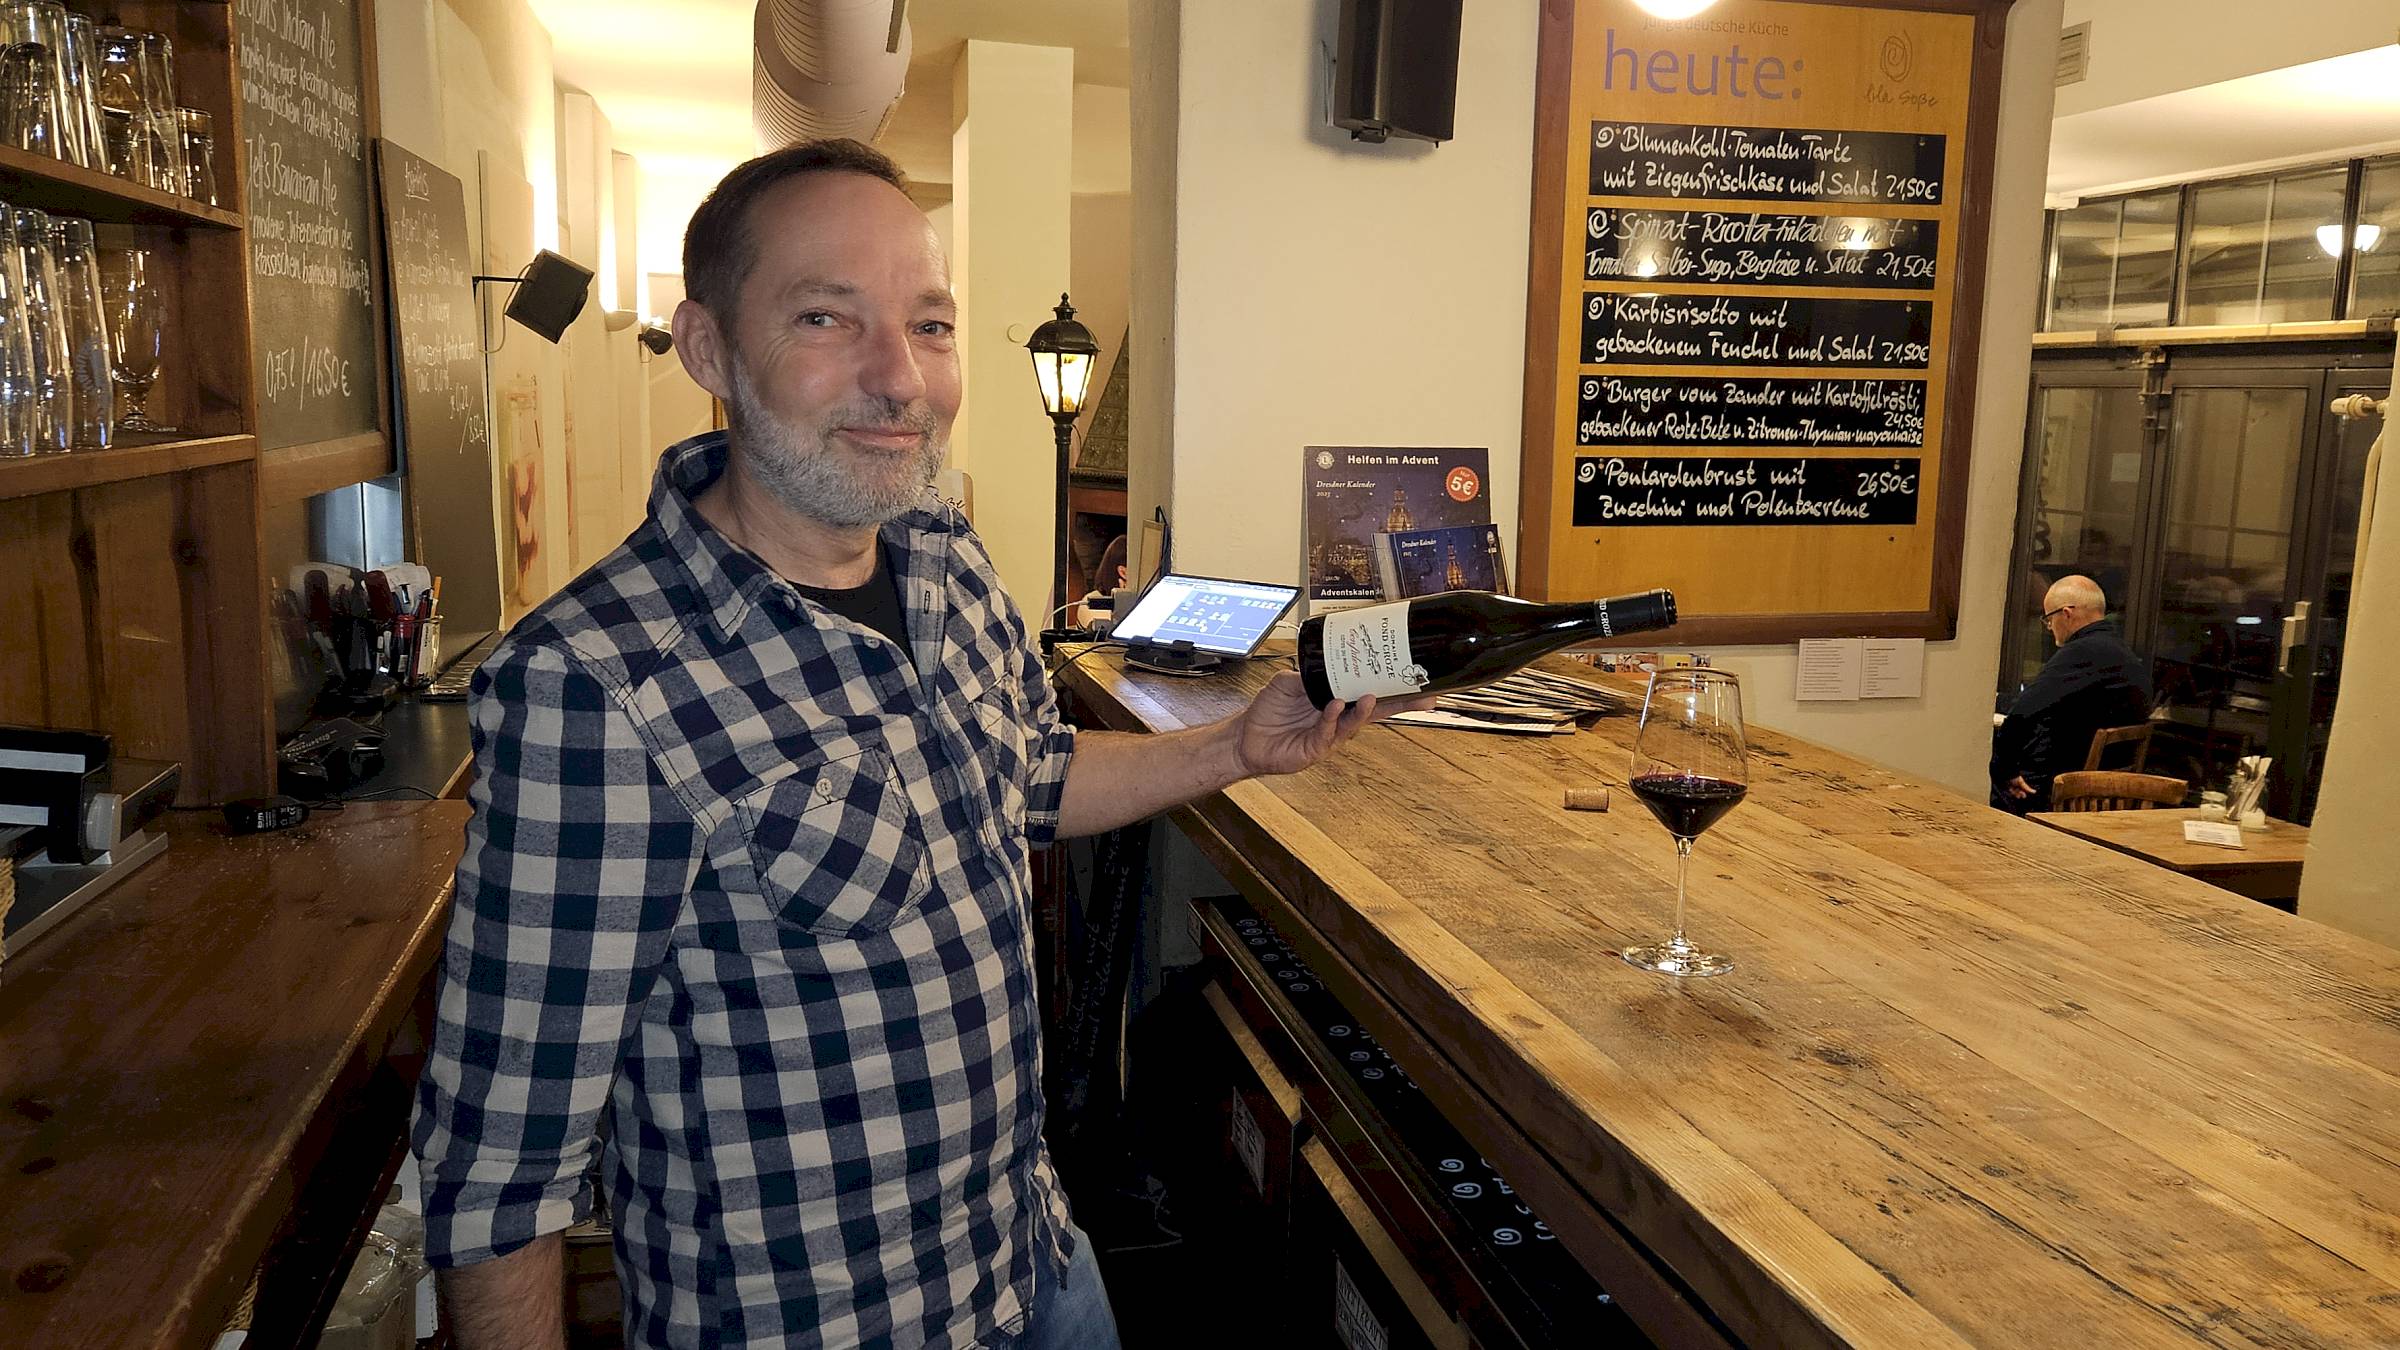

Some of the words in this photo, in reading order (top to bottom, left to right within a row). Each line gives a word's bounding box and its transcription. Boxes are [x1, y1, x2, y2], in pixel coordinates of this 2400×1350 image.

[1684, 18, 1746, 33] deutsche
[1749, 20, 1789, 36] Küche
[1604, 28, 1804, 101] heute:
[320, 159, 339, 216] Ale
[1603, 160, 1637, 188] mit
[1645, 161, 1785, 197] Ziegenfrischkäse
[1790, 170, 1826, 195] und
[1827, 169, 1879, 198] Salat
[1823, 248, 1870, 275] Salat
[1614, 296, 1740, 327] Kürbisrisotto
[1749, 299, 1788, 329] mit
[1594, 327, 1702, 364] gebackenem
[1708, 330, 1779, 361] Fenchel
[1788, 334, 1825, 361] und
[1828, 333, 1876, 362] Salat
[1607, 379, 1672, 413] Burger
[1679, 386, 1719, 404] vom
[1723, 380, 1785, 407] Zander
[1792, 380, 1822, 406] mit
[1580, 409, 1664, 443] gebackener
[1347, 454, 1383, 465] Helfen
[1386, 454, 1399, 465] im
[1402, 455, 1439, 465] Advent
[1770, 459, 1807, 486] mit
[1316, 480, 1346, 489] Dresdner
[1347, 480, 1376, 489] Kalender
[1450, 476, 1474, 496] 5€
[1598, 489, 1686, 519] Zucchini
[1696, 492, 1735, 517] und
[1740, 488, 1870, 519] Polentacreme
[1390, 629, 1398, 661] DOMAINE
[1383, 644, 1395, 679] CROZE
